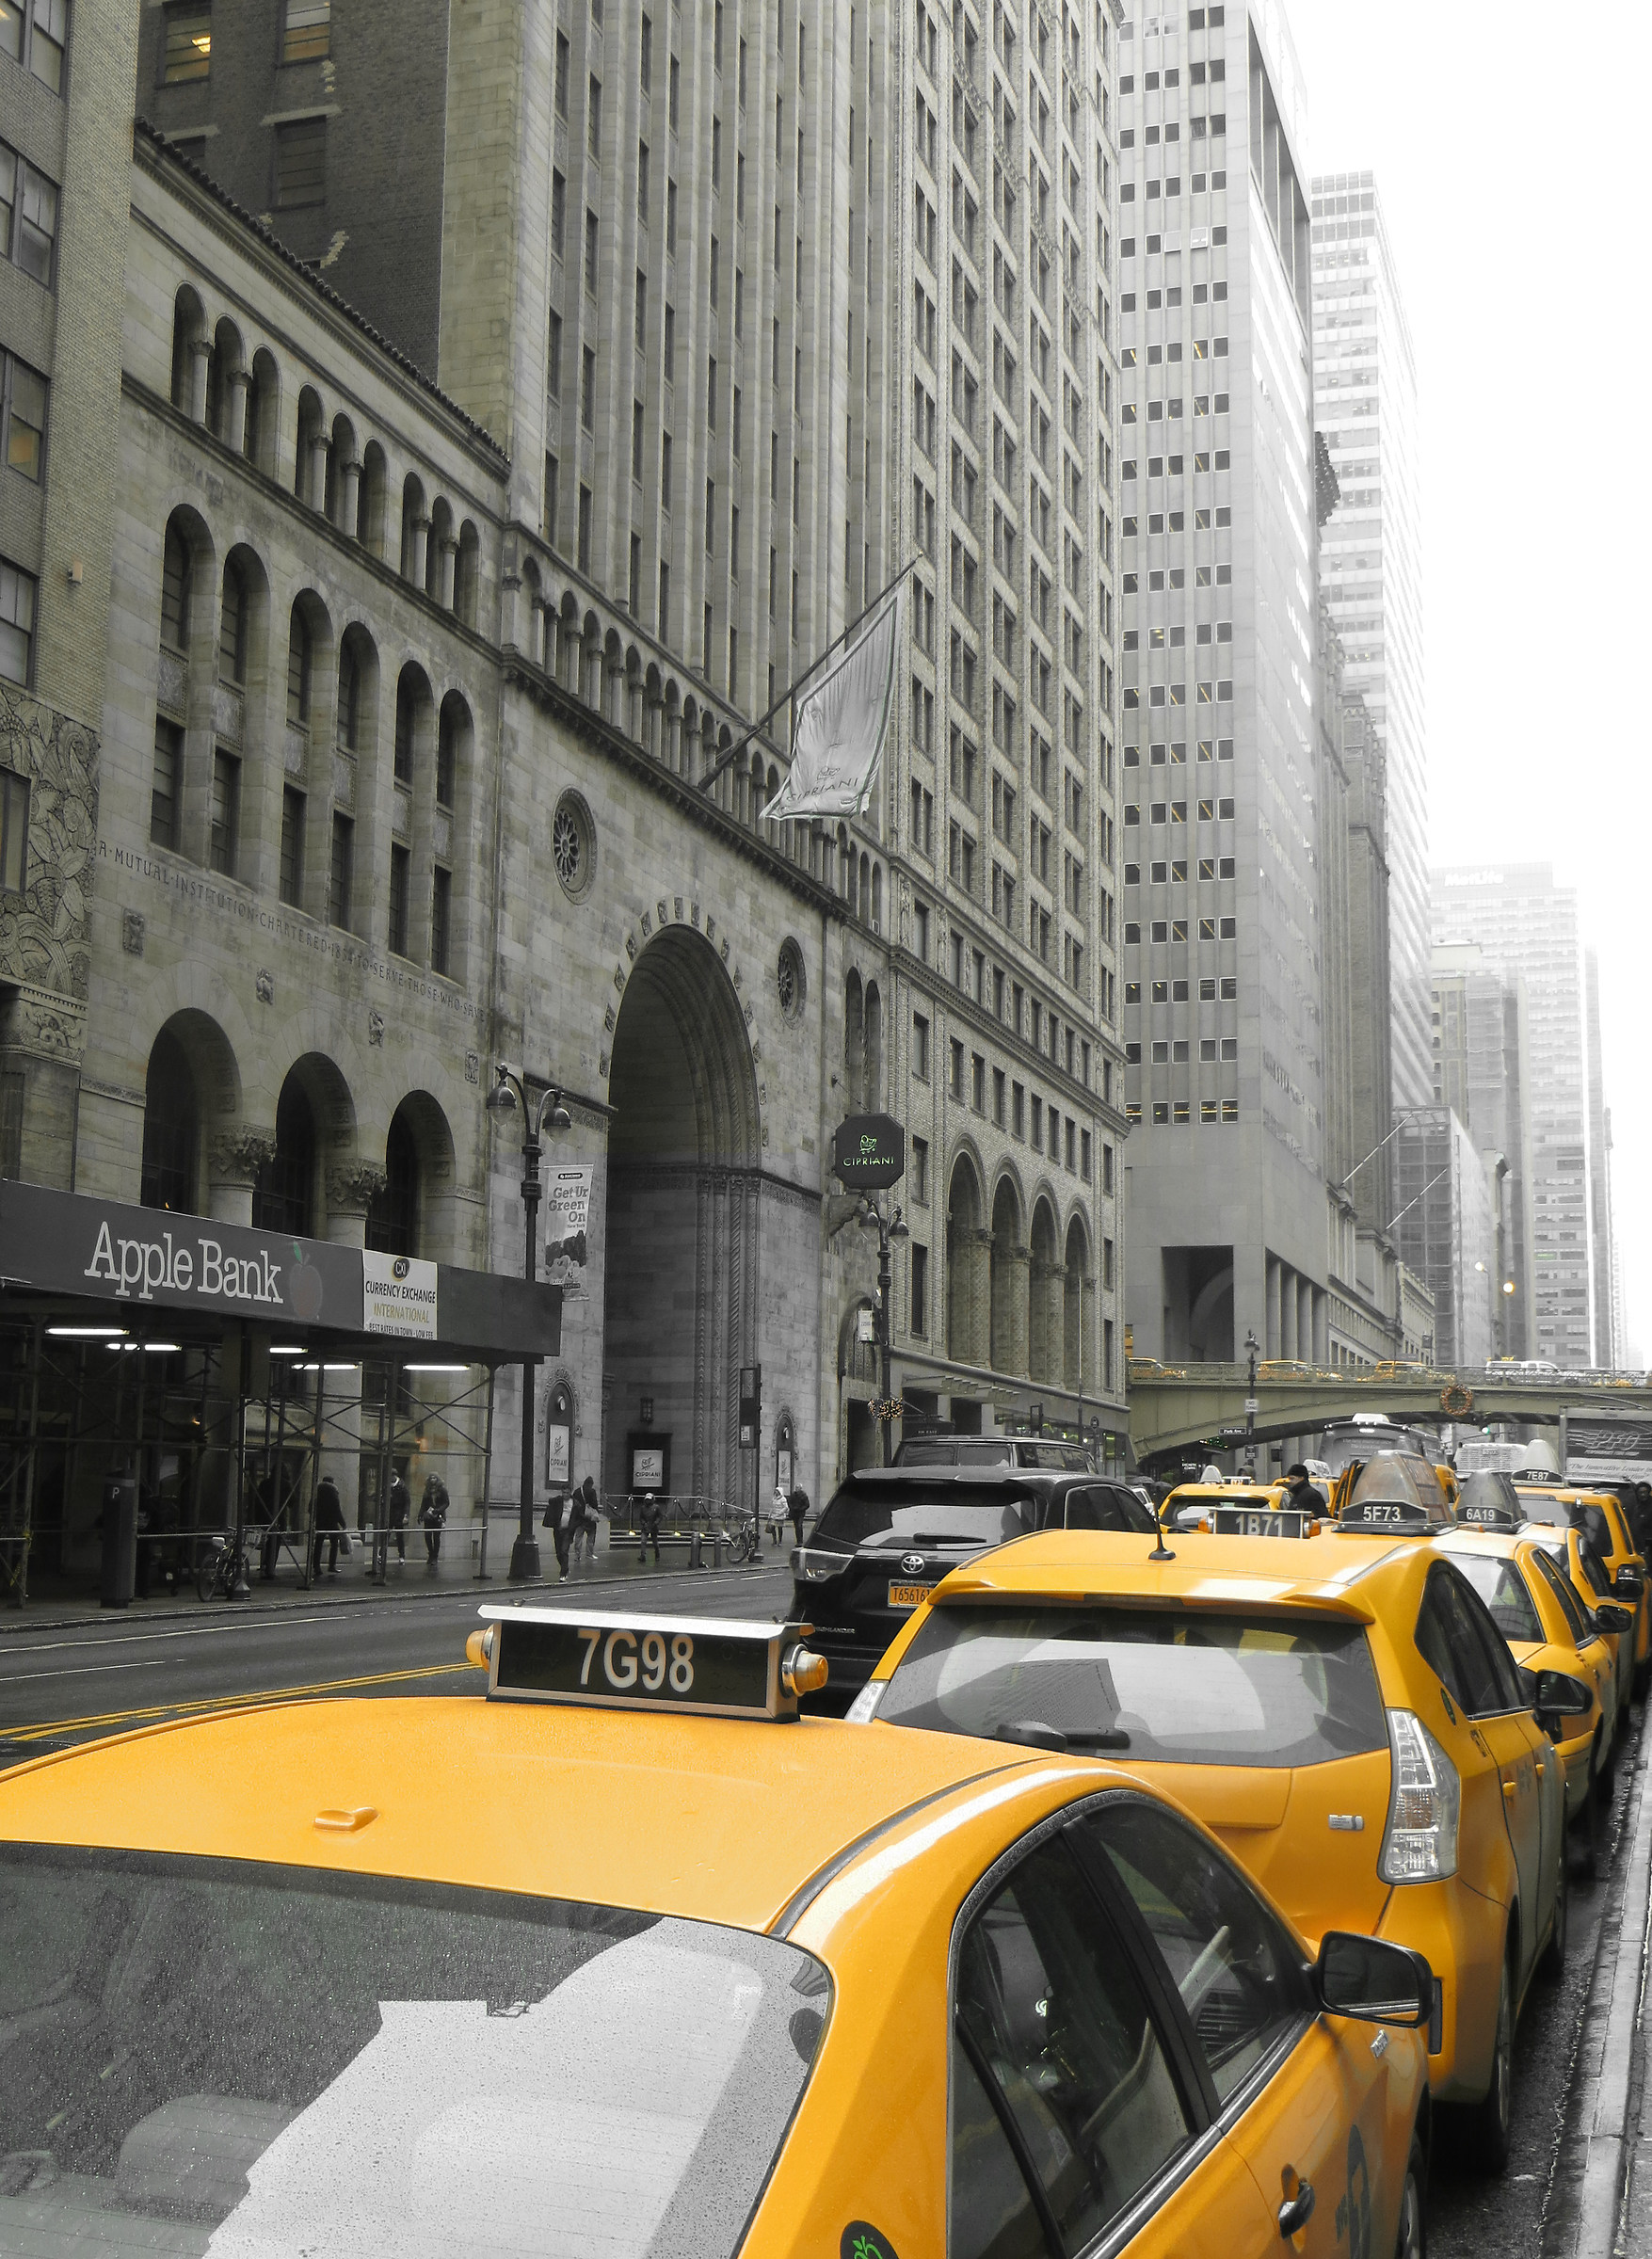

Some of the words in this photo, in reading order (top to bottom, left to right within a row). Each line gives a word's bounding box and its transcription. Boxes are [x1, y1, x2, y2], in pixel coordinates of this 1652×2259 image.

[786, 777, 858, 802] CIPRIANI
[1444, 871, 1505, 887] MetLife
[114, 847, 169, 886] MUTUAL
[176, 873, 255, 922] INSTITUTION
[259, 913, 328, 953] CHARTERED
[357, 954, 370, 971] TO
[373, 962, 405, 987] SERVE
[408, 977, 438, 1001] THOSE
[440, 991, 460, 1011] WHO
[463, 1002, 486, 1023] SAVE
[842, 1157, 895, 1166] CIPRIANI
[553, 1187, 574, 1199] Get
[576, 1186, 589, 1198] Ur
[548, 1199, 585, 1212] Green
[568, 1210, 586, 1224] On
[84, 1220, 193, 1301] Apple
[197, 1238, 283, 1305] Bank
[365, 1280, 401, 1298] CURRENCY
[402, 1287, 436, 1304] EXCHANGE
[374, 1302, 430, 1323] INTERNATIONAL
[369, 1322, 380, 1334] BEST
[380, 1324, 393, 1335] RATES
[400, 1327, 413, 1337] TOWN
[425, 1330, 434, 1339] FEE
[1526, 1471, 1549, 1481] 7E87
[112, 1487, 120, 1499] P
[1362, 1506, 1402, 1522] 5F73
[1466, 1508, 1496, 1521] 6A19
[1235, 1512, 1284, 1537] 1B71
[576, 1626, 695, 1693] 7G98
